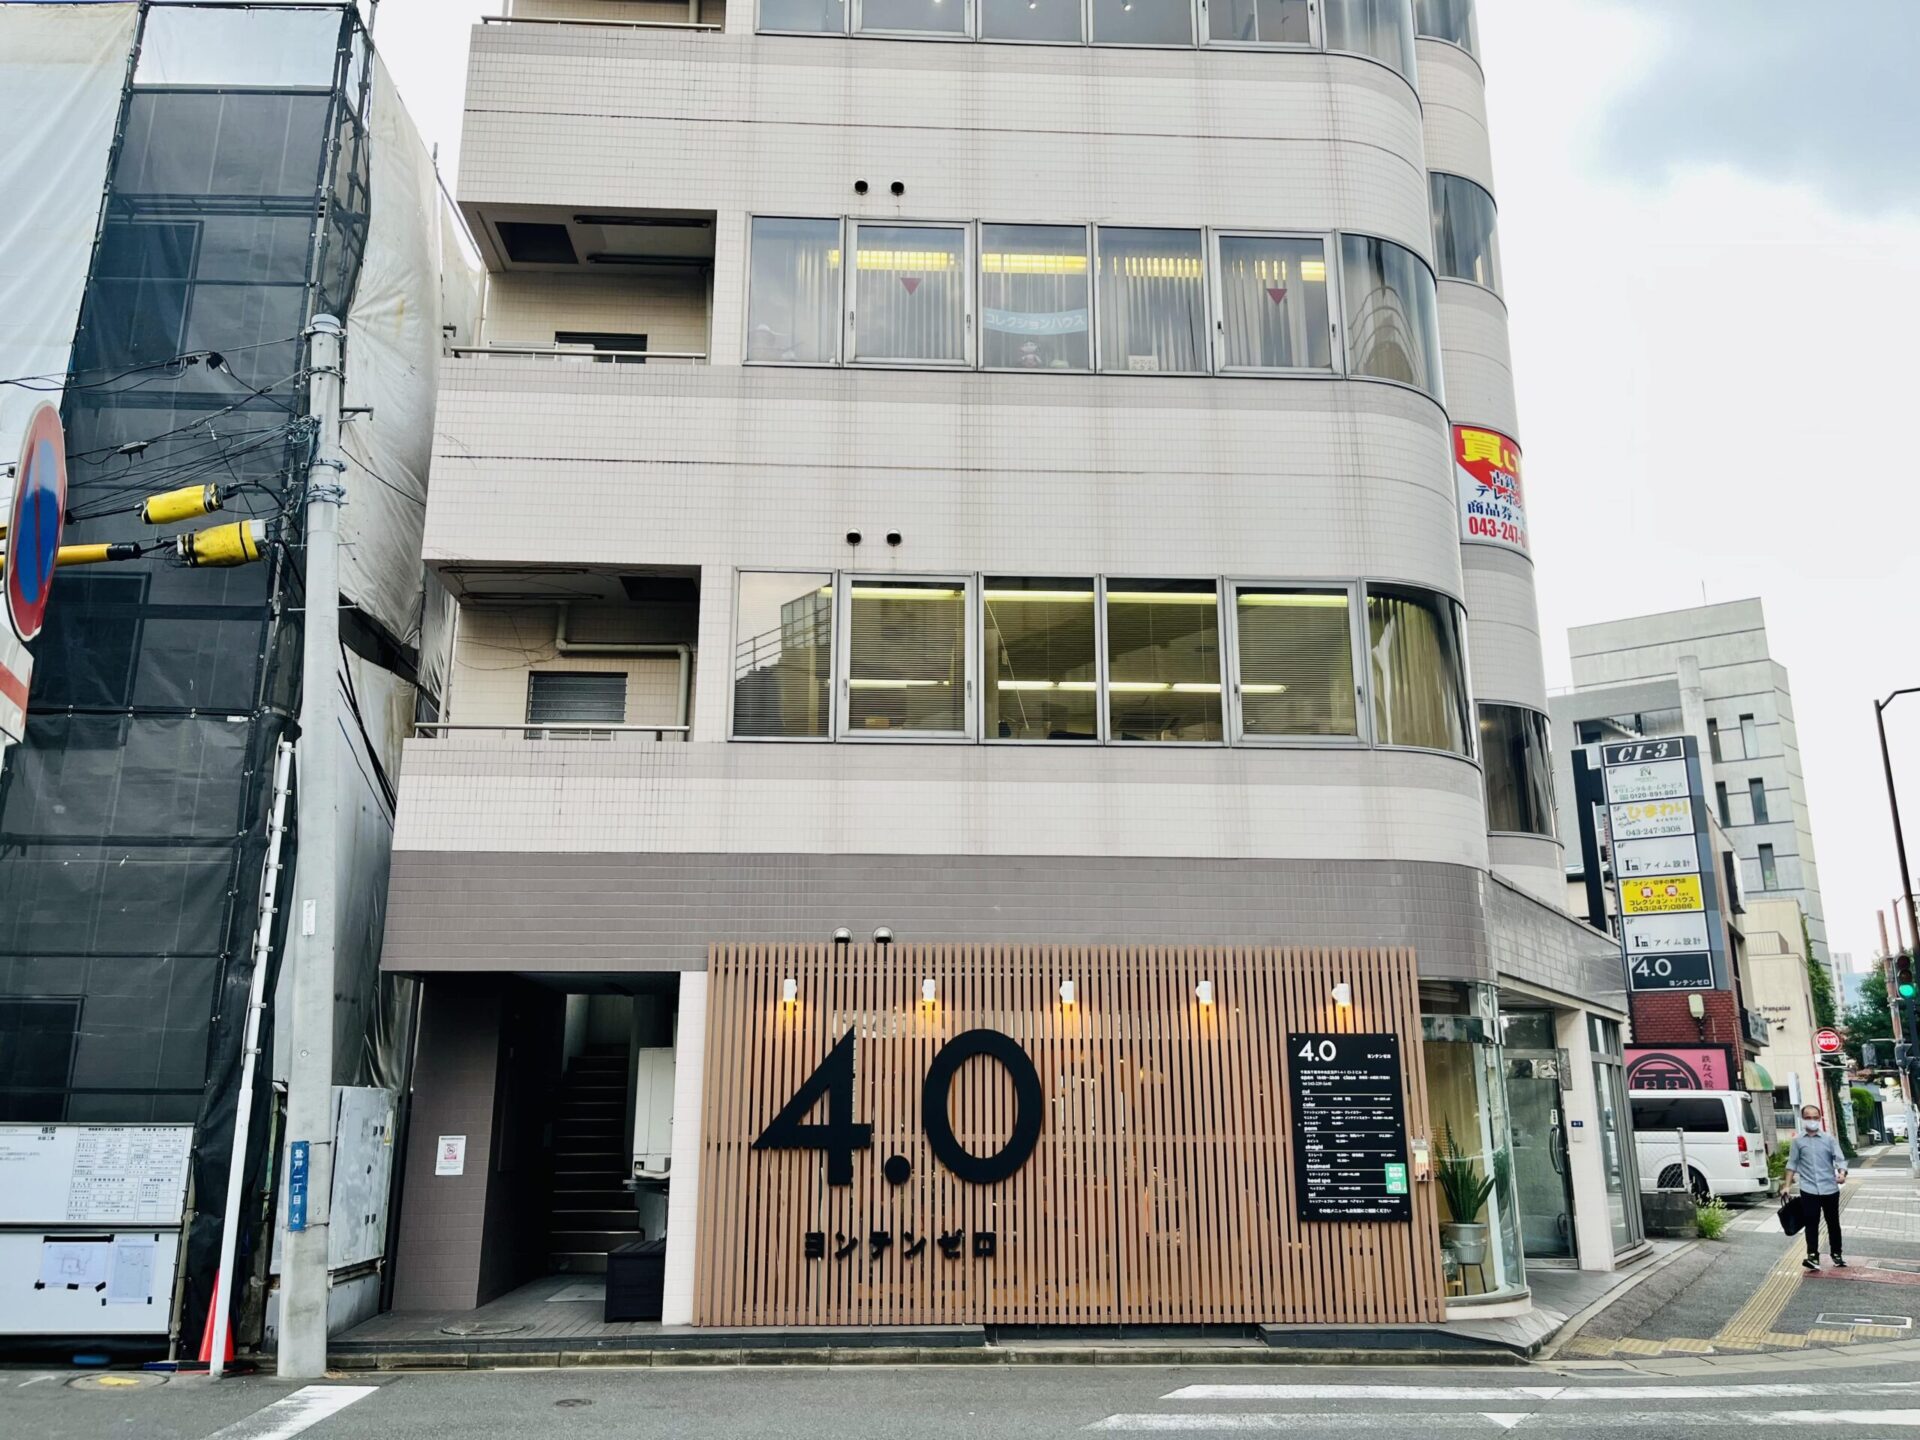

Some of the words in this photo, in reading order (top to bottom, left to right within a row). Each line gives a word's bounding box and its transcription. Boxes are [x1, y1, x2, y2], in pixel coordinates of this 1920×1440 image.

[985, 313, 1086, 330] コレクションハウス
[1618, 743, 1668, 762] CI-3
[1627, 800, 1689, 820] ひまわり
[1644, 859, 1691, 869] アイム設計
[1629, 896, 1695, 906] コレクション・ハウス
[1654, 936, 1702, 946] アイム設計
[1635, 958, 1672, 977] 4.0
[1298, 1039, 1337, 1062] 4.0
[751, 1025, 1043, 1186] 4.0
[292, 1149, 304, 1205] 登戸一丁目
[292, 1213, 300, 1224] 4
[804, 1228, 996, 1260] ヨンテンゼロ
